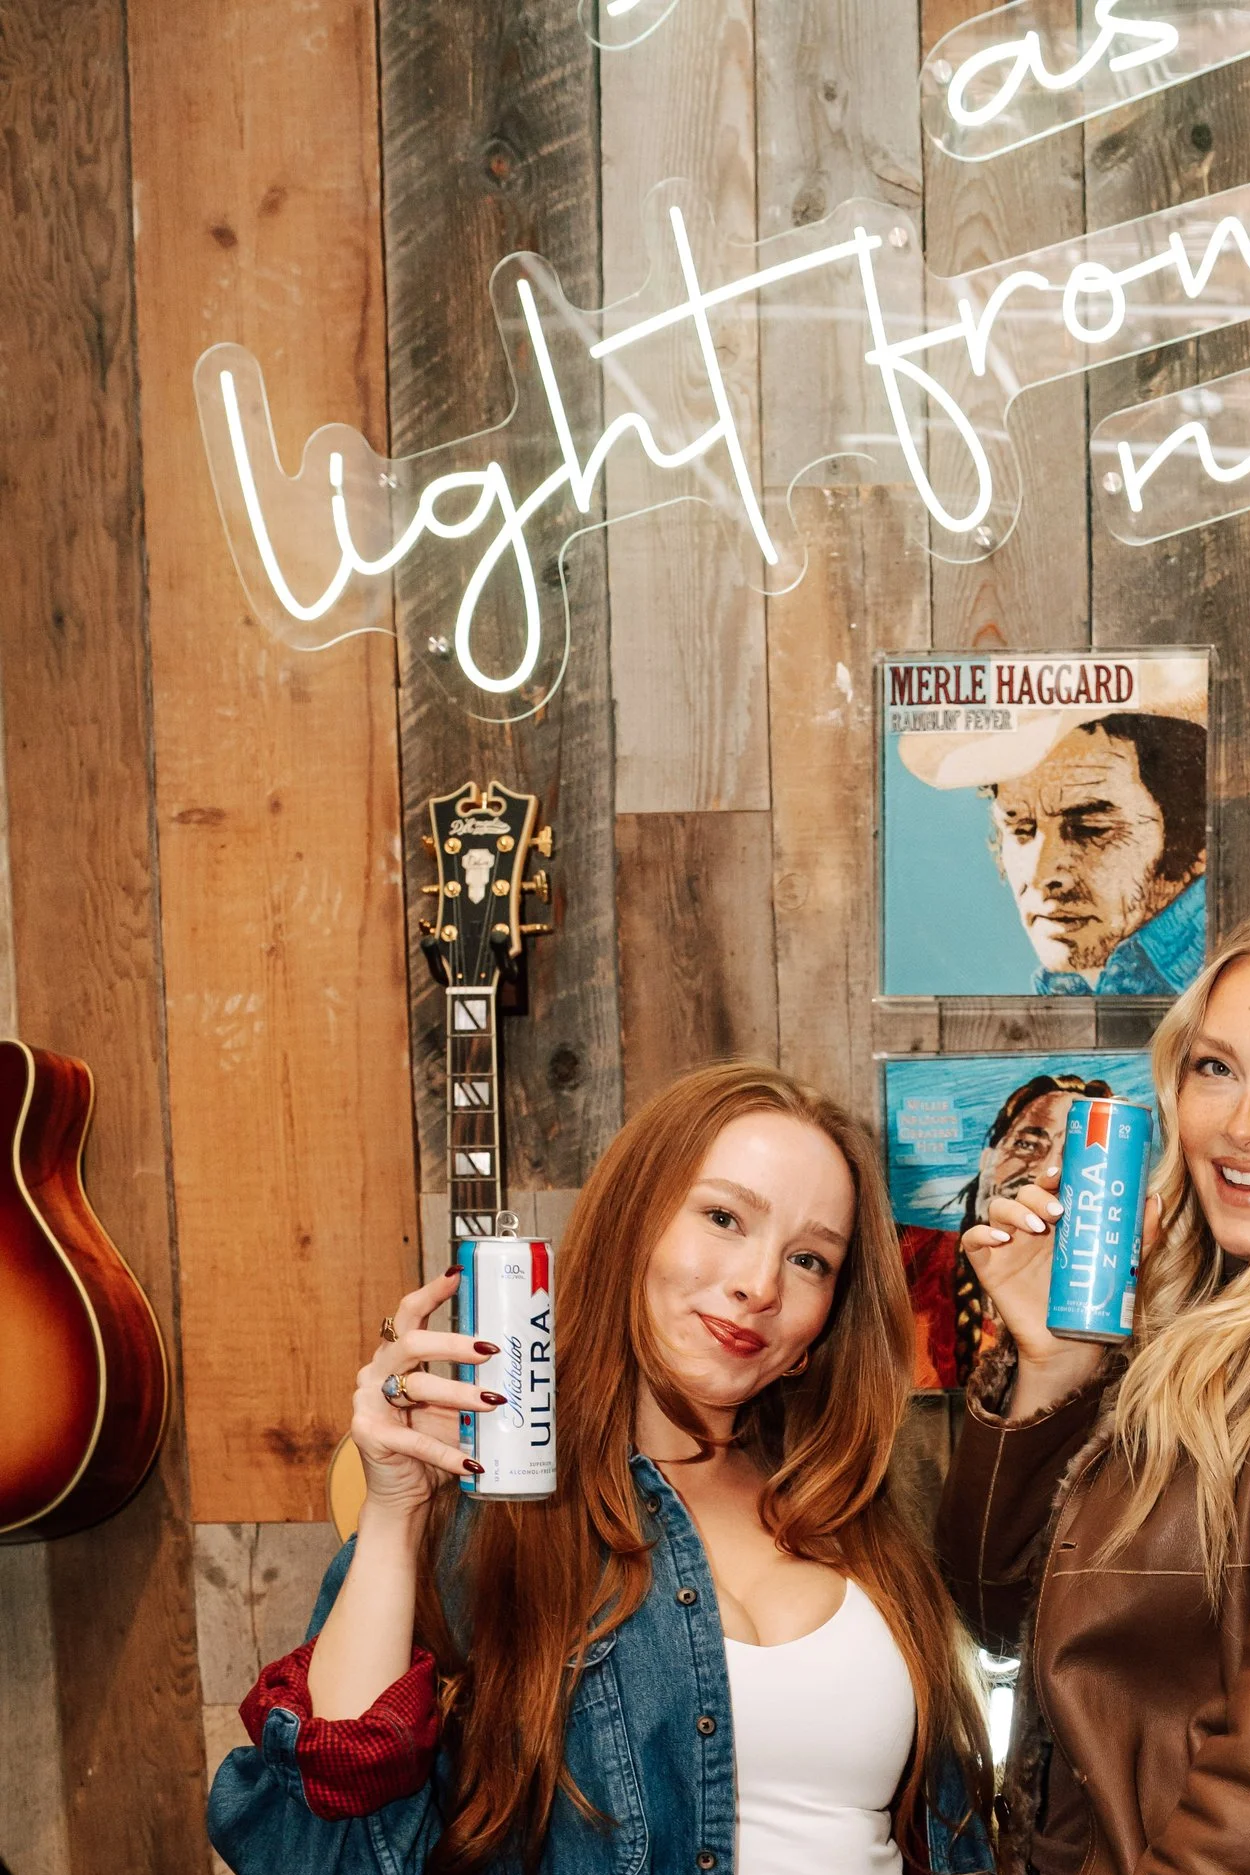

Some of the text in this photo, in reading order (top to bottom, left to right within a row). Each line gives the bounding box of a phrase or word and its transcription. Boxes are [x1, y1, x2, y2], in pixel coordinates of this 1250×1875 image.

[221, 205, 882, 694] light
[889, 664, 1135, 706] MERLE HAGGARD
[964, 709, 1013, 731] FEVER
[1118, 1124, 1131, 1135] 29
[1069, 1160, 1109, 1290] ULTRA
[1103, 1180, 1126, 1269] ZERO
[502, 1335, 525, 1429] Michelob
[530, 1309, 551, 1447] ULTRA
